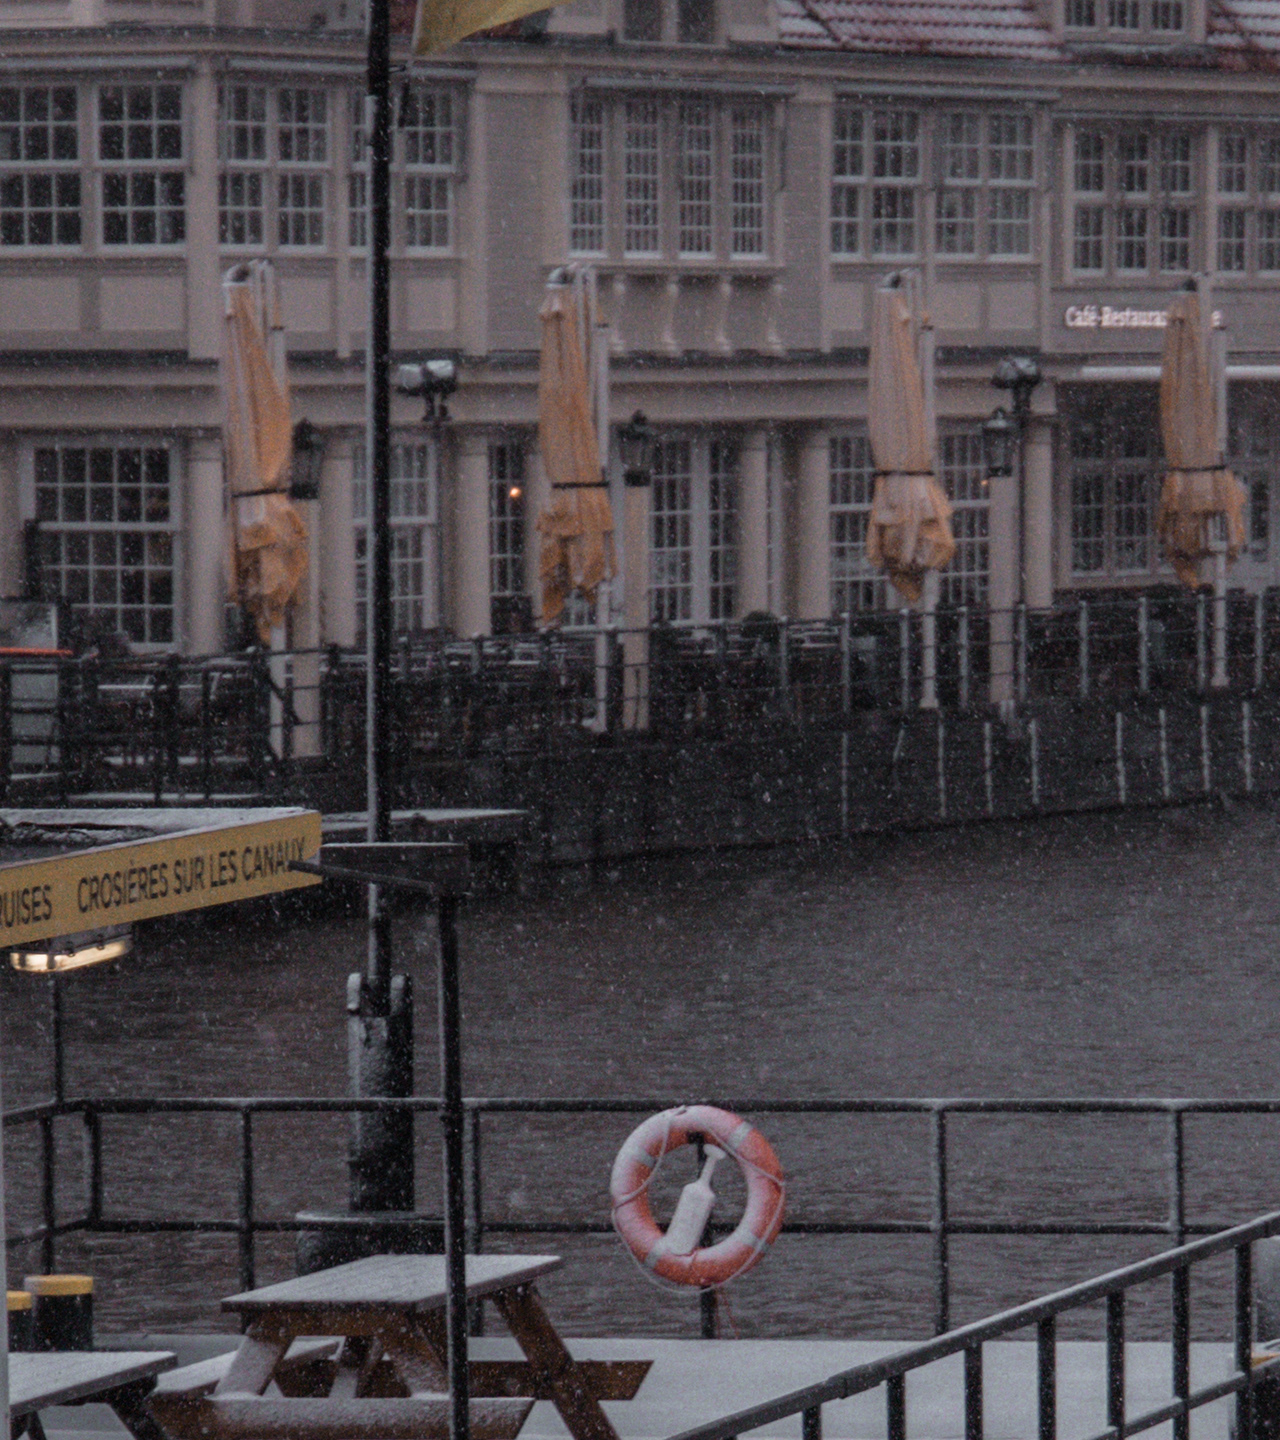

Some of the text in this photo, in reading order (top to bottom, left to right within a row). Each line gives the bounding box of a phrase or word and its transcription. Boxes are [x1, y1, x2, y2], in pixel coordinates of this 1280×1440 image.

[173, 855, 207, 895] SUR
[210, 850, 239, 889] LES
[242, 839, 306, 883] CANAUX
